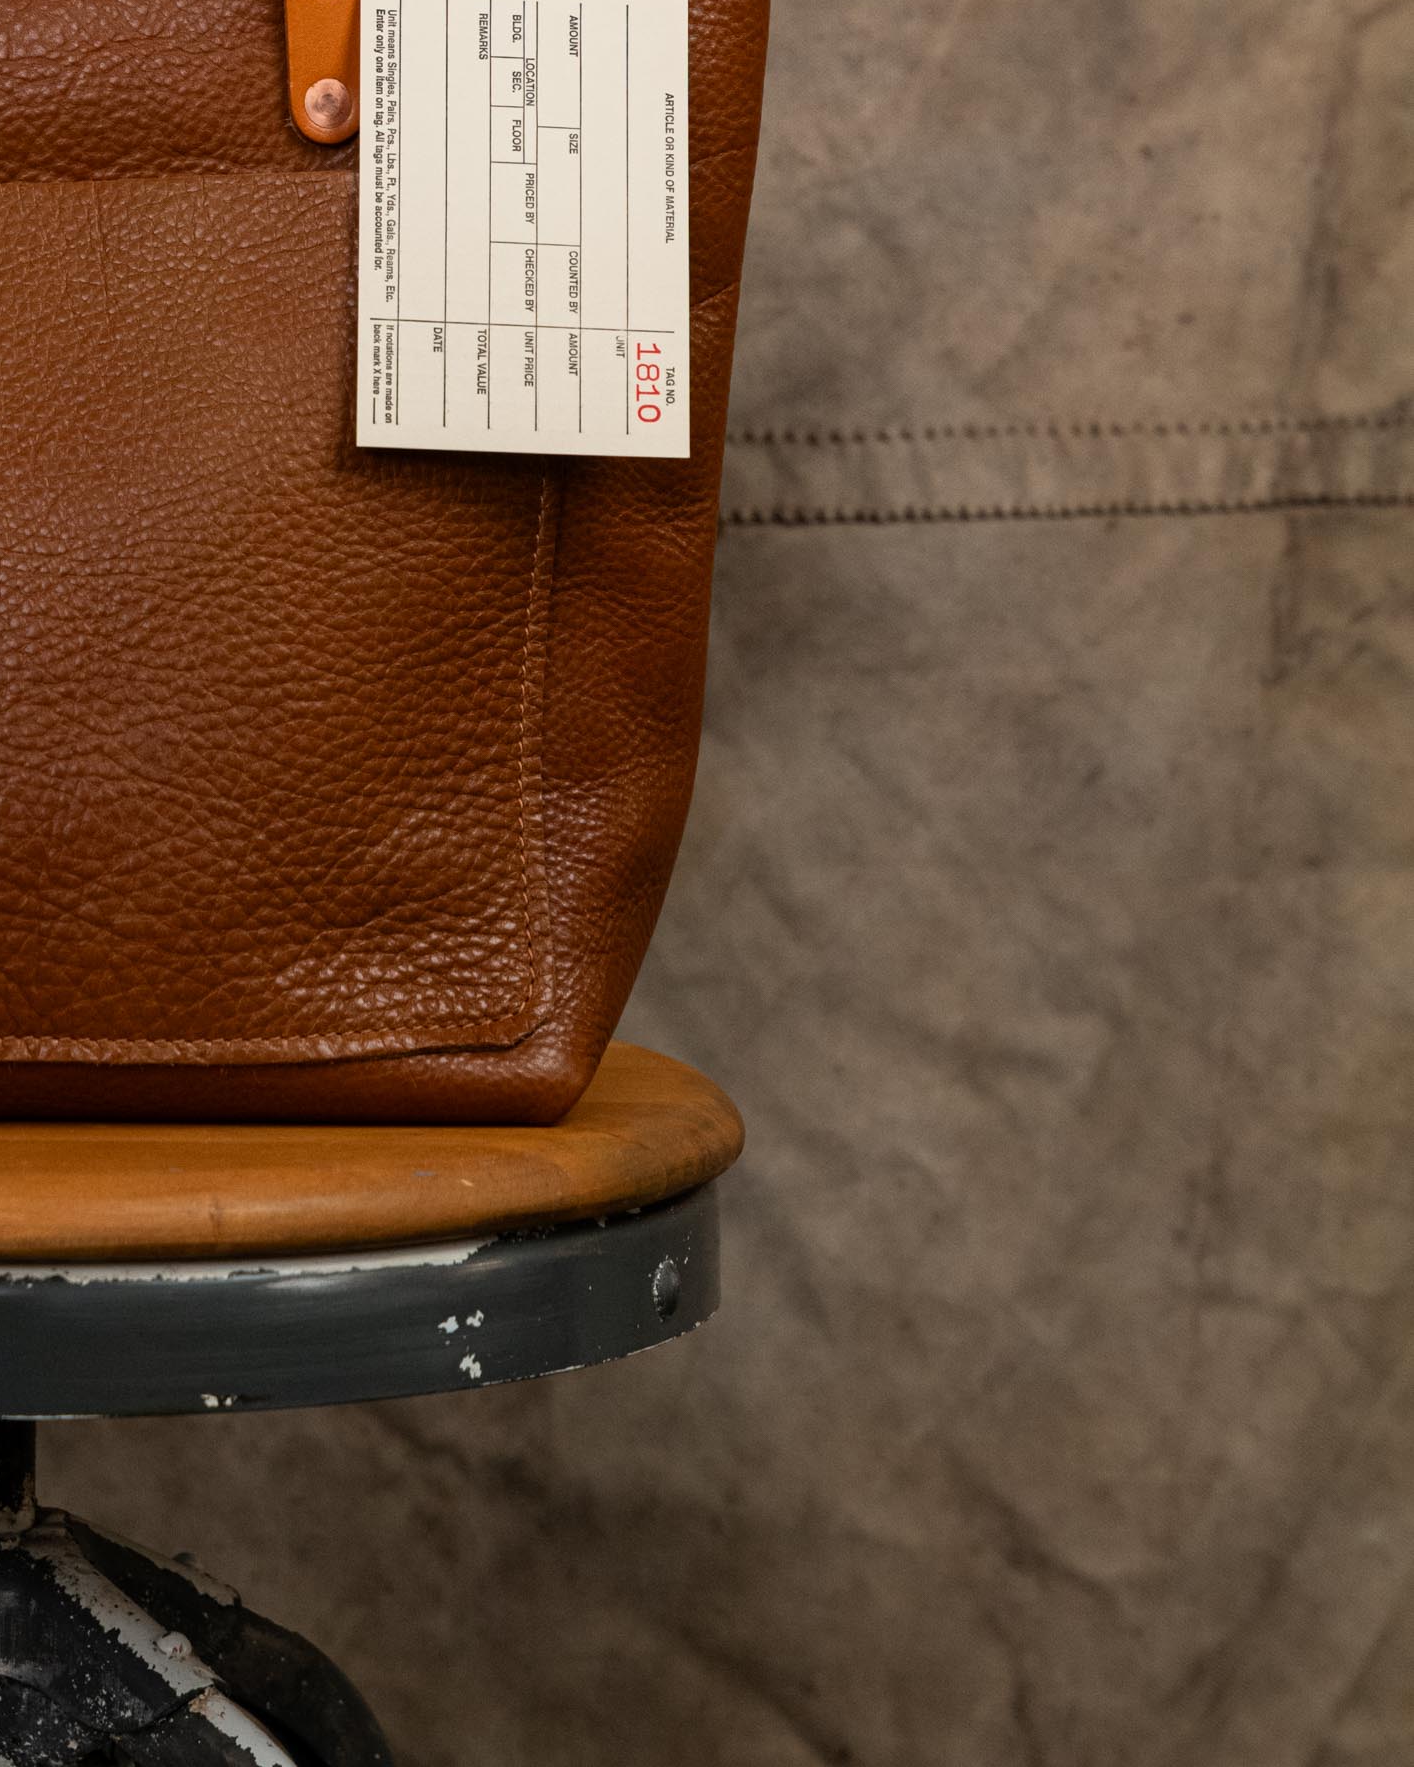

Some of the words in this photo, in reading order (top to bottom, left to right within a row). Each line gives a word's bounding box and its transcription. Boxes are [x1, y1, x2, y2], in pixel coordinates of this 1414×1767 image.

[376, 9, 386, 33] Enter
[387, 9, 398, 27] Unit
[511, 14, 522, 44] BLDG.
[374, 35, 385, 54] only
[387, 30, 396, 59] means
[478, 13, 489, 60] REMARKS
[568, 14, 579, 57] AMOUNT
[376, 56, 384, 73] one
[376, 75, 385, 95] item
[386, 61, 397, 97] Singles,
[511, 70, 521, 94] SEC.
[525, 57, 535, 107] LOCATION
[376, 97, 383, 109] on
[386, 100, 397, 125] Pairs,
[664, 92, 675, 134] ARTICLE
[373, 111, 384, 128] tag.
[375, 130, 384, 142] All
[511, 119, 521, 152] FLOOR
[568, 132, 578, 155] SIZE
[664, 136, 674, 151] OR
[373, 145, 384, 164] tags
[664, 152, 675, 178] KIND
[375, 167, 384, 189] must
[664, 179, 675, 193] OF
[375, 192, 384, 203] be
[524, 172, 535, 209] PRICED
[375, 205, 384, 254] accounted
[524, 211, 535, 225] BY
[664, 195, 675, 244] MATERIAL
[374, 256, 384, 271] for.
[384, 248, 395, 283] Reams,
[524, 248, 535, 297] CHECKED
[568, 250, 578, 299] COUNTED
[386, 285, 395, 303] Etc.
[524, 298, 535, 313] BY
[568, 301, 578, 314] BY
[373, 324, 382, 344] back
[432, 327, 443, 353] DATE
[477, 329, 487, 360] TOTAL
[523, 331, 534, 354] UNIT
[373, 345, 381, 367] mark
[385, 332, 394, 370] notations
[568, 332, 578, 376] AMOUNT
[476, 363, 487, 395] VALUE
[523, 357, 534, 387] PRICE
[635, 342, 662, 424] 1810
[665, 367, 675, 389] TAG
[373, 376, 381, 395] here
[385, 388, 393, 411] made
[665, 390, 675, 406] NO.
[385, 412, 392, 424] on
